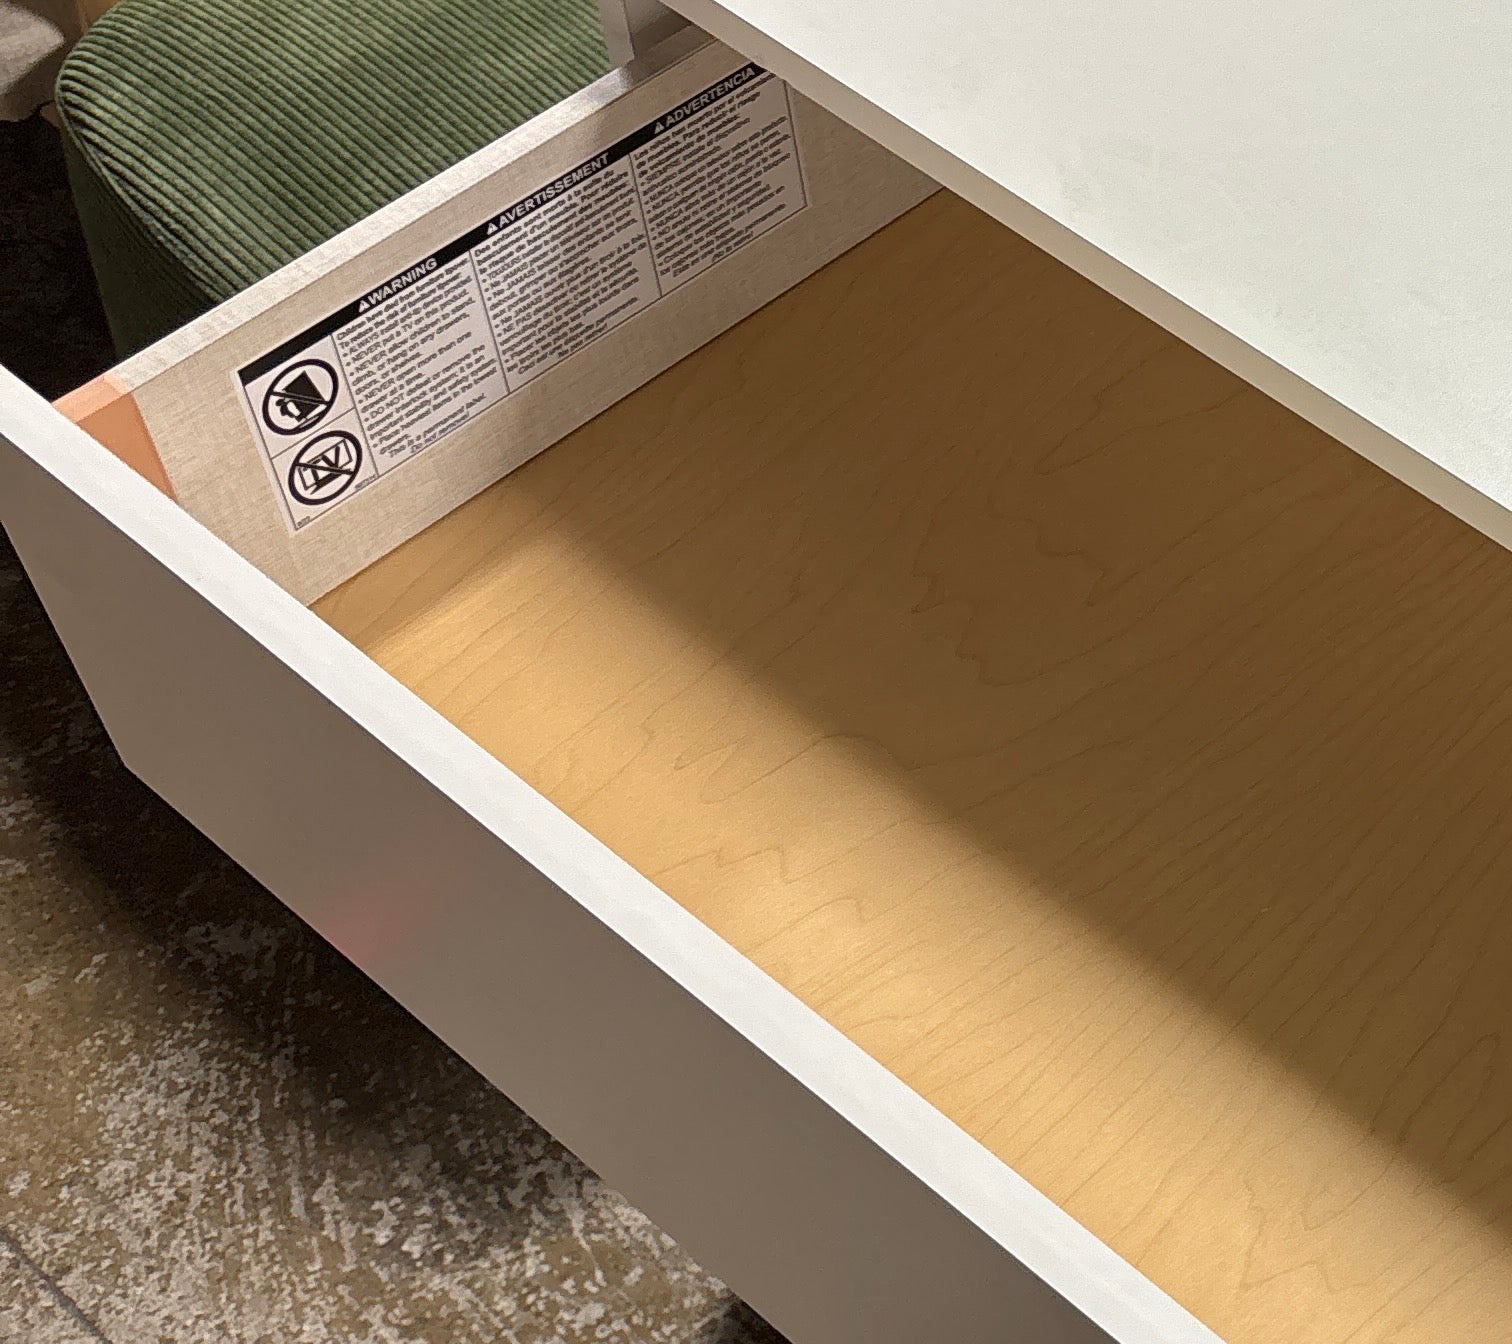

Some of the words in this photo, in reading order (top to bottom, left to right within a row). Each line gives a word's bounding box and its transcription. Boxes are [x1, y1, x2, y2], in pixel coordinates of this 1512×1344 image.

[366, 255, 438, 307] WARNING
[497, 150, 611, 228] AVERTISSEMENT
[663, 63, 755, 128] ADVERTENCIA
